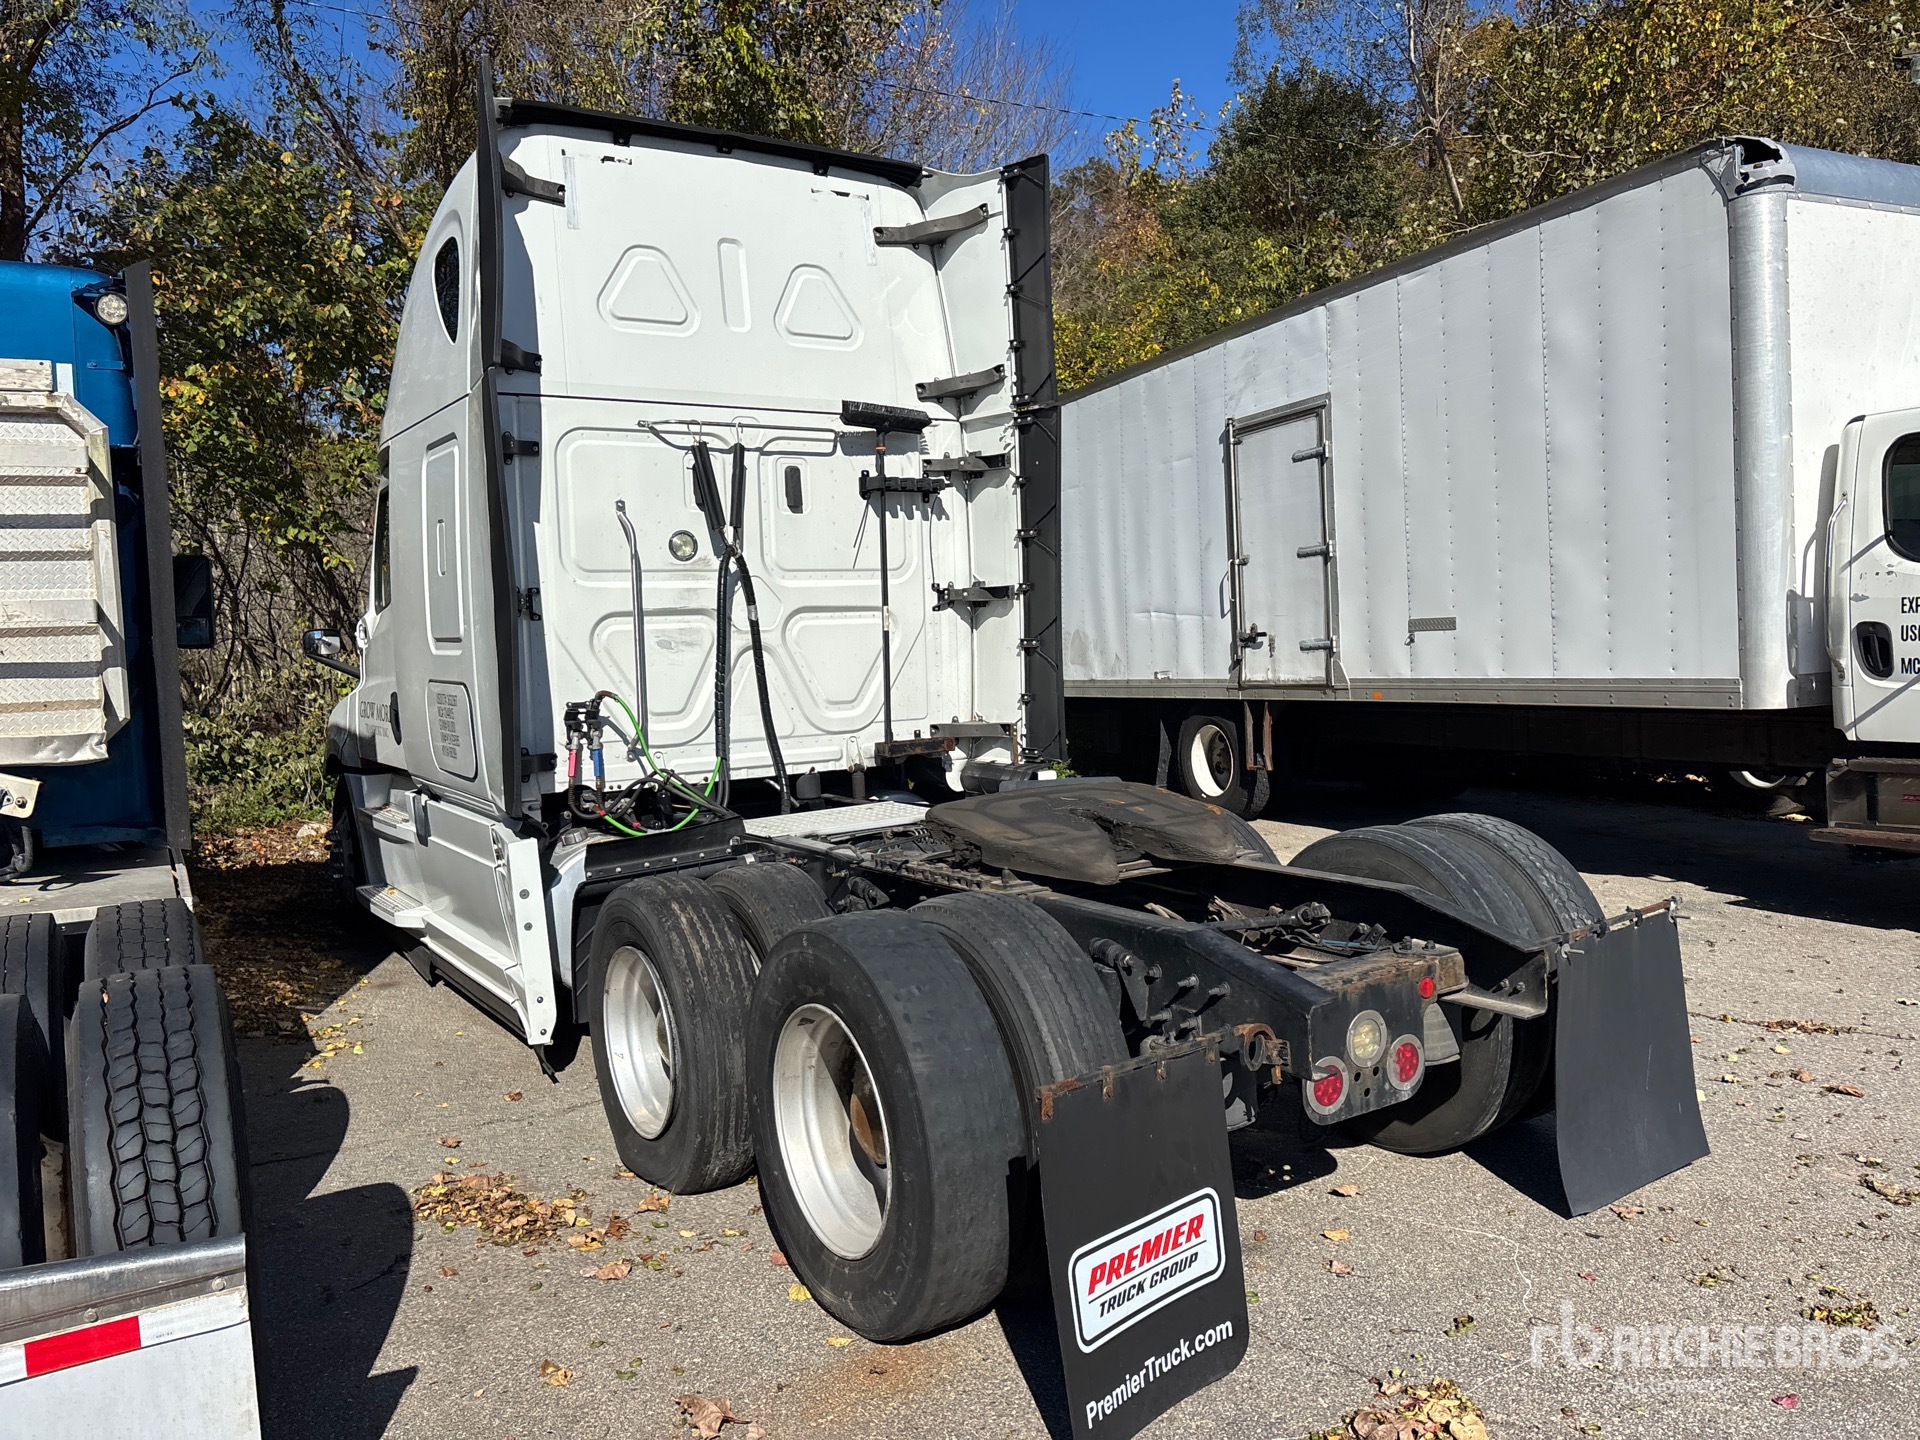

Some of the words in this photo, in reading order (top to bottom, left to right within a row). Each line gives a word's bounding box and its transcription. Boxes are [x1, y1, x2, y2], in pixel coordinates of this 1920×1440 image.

[1901, 625, 1920, 642] US
[1088, 1213, 1204, 1296] PREMIER
[1099, 1277, 1148, 1318] TRUCK
[1149, 1252, 1199, 1289] GROUP
[1085, 1320, 1234, 1429] PremierTruck.com
